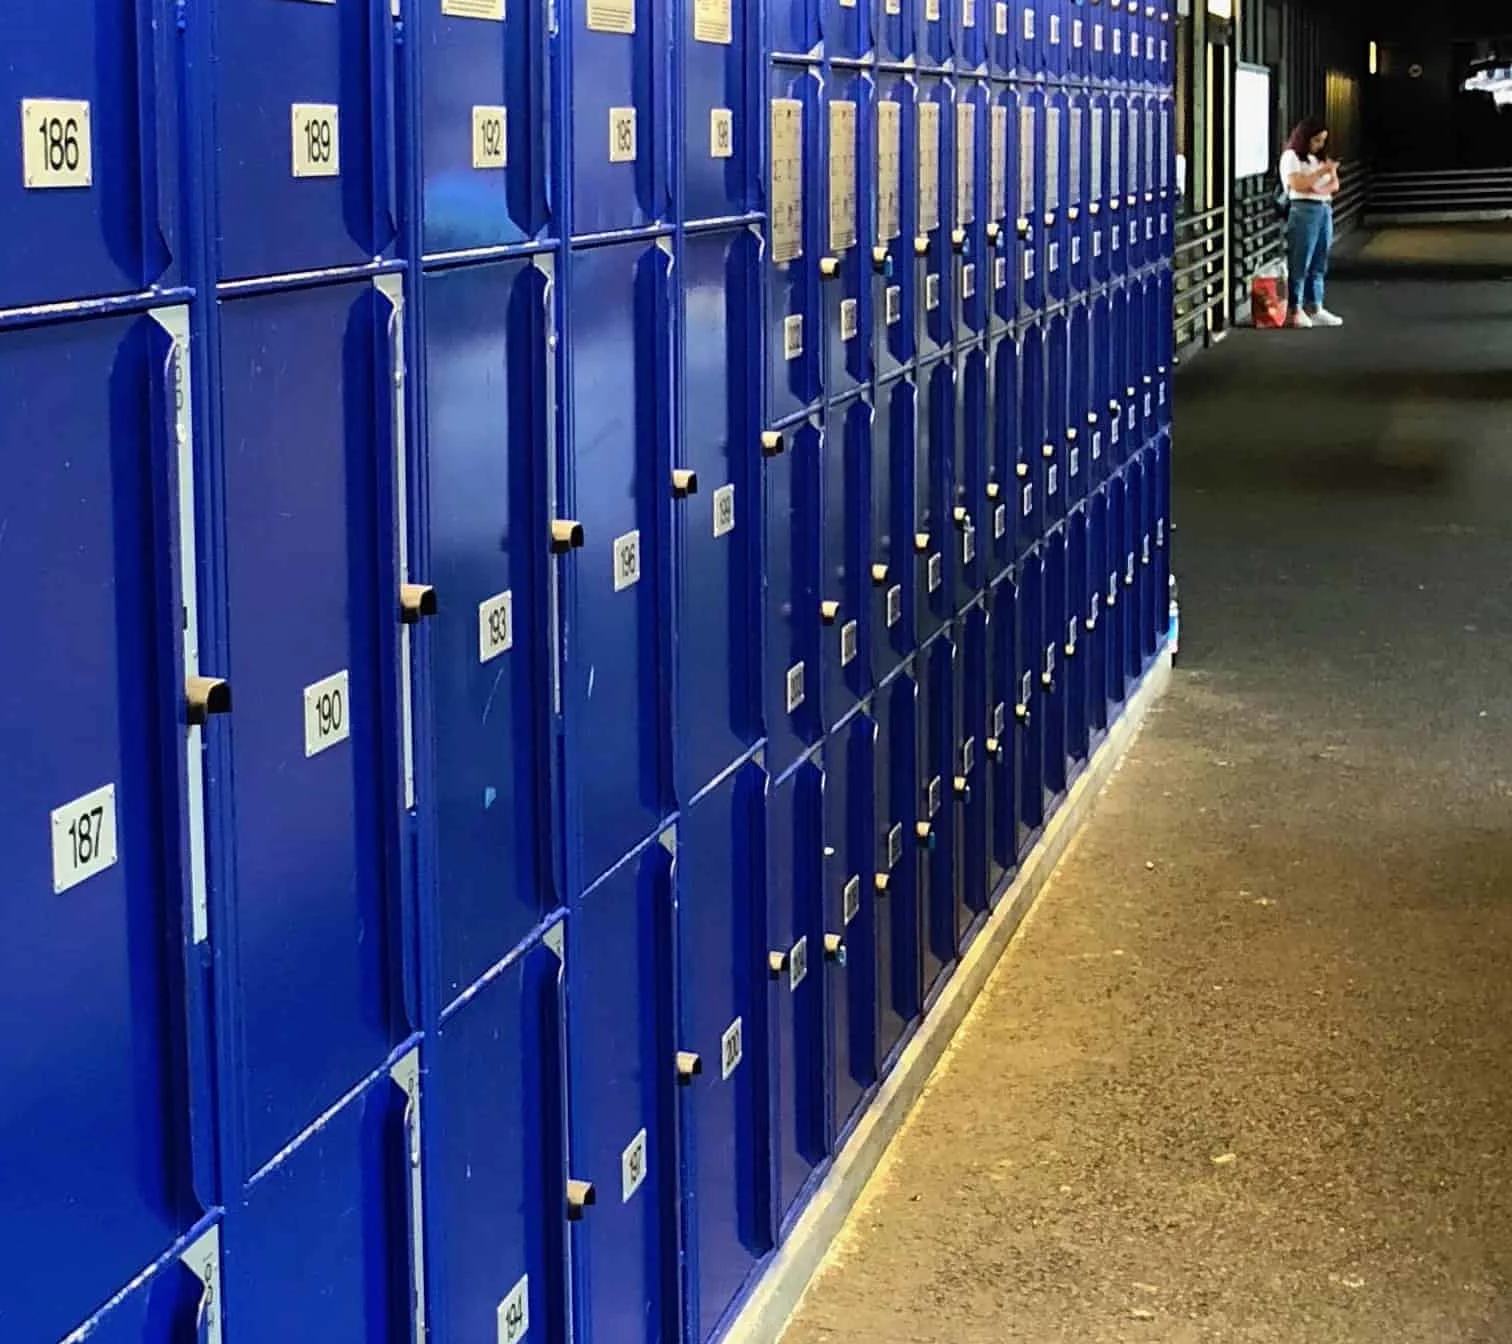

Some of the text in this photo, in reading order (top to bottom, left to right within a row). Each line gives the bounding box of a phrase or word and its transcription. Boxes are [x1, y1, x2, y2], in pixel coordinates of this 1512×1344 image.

[39, 117, 79, 171] 186
[304, 119, 332, 163] 189
[481, 118, 501, 156] 192
[619, 542, 636, 578] 196
[488, 605, 507, 646] 193
[315, 690, 342, 738] 190
[67, 805, 104, 869] 187
[629, 1141, 642, 1183] 197
[506, 1293, 524, 1344] 194
